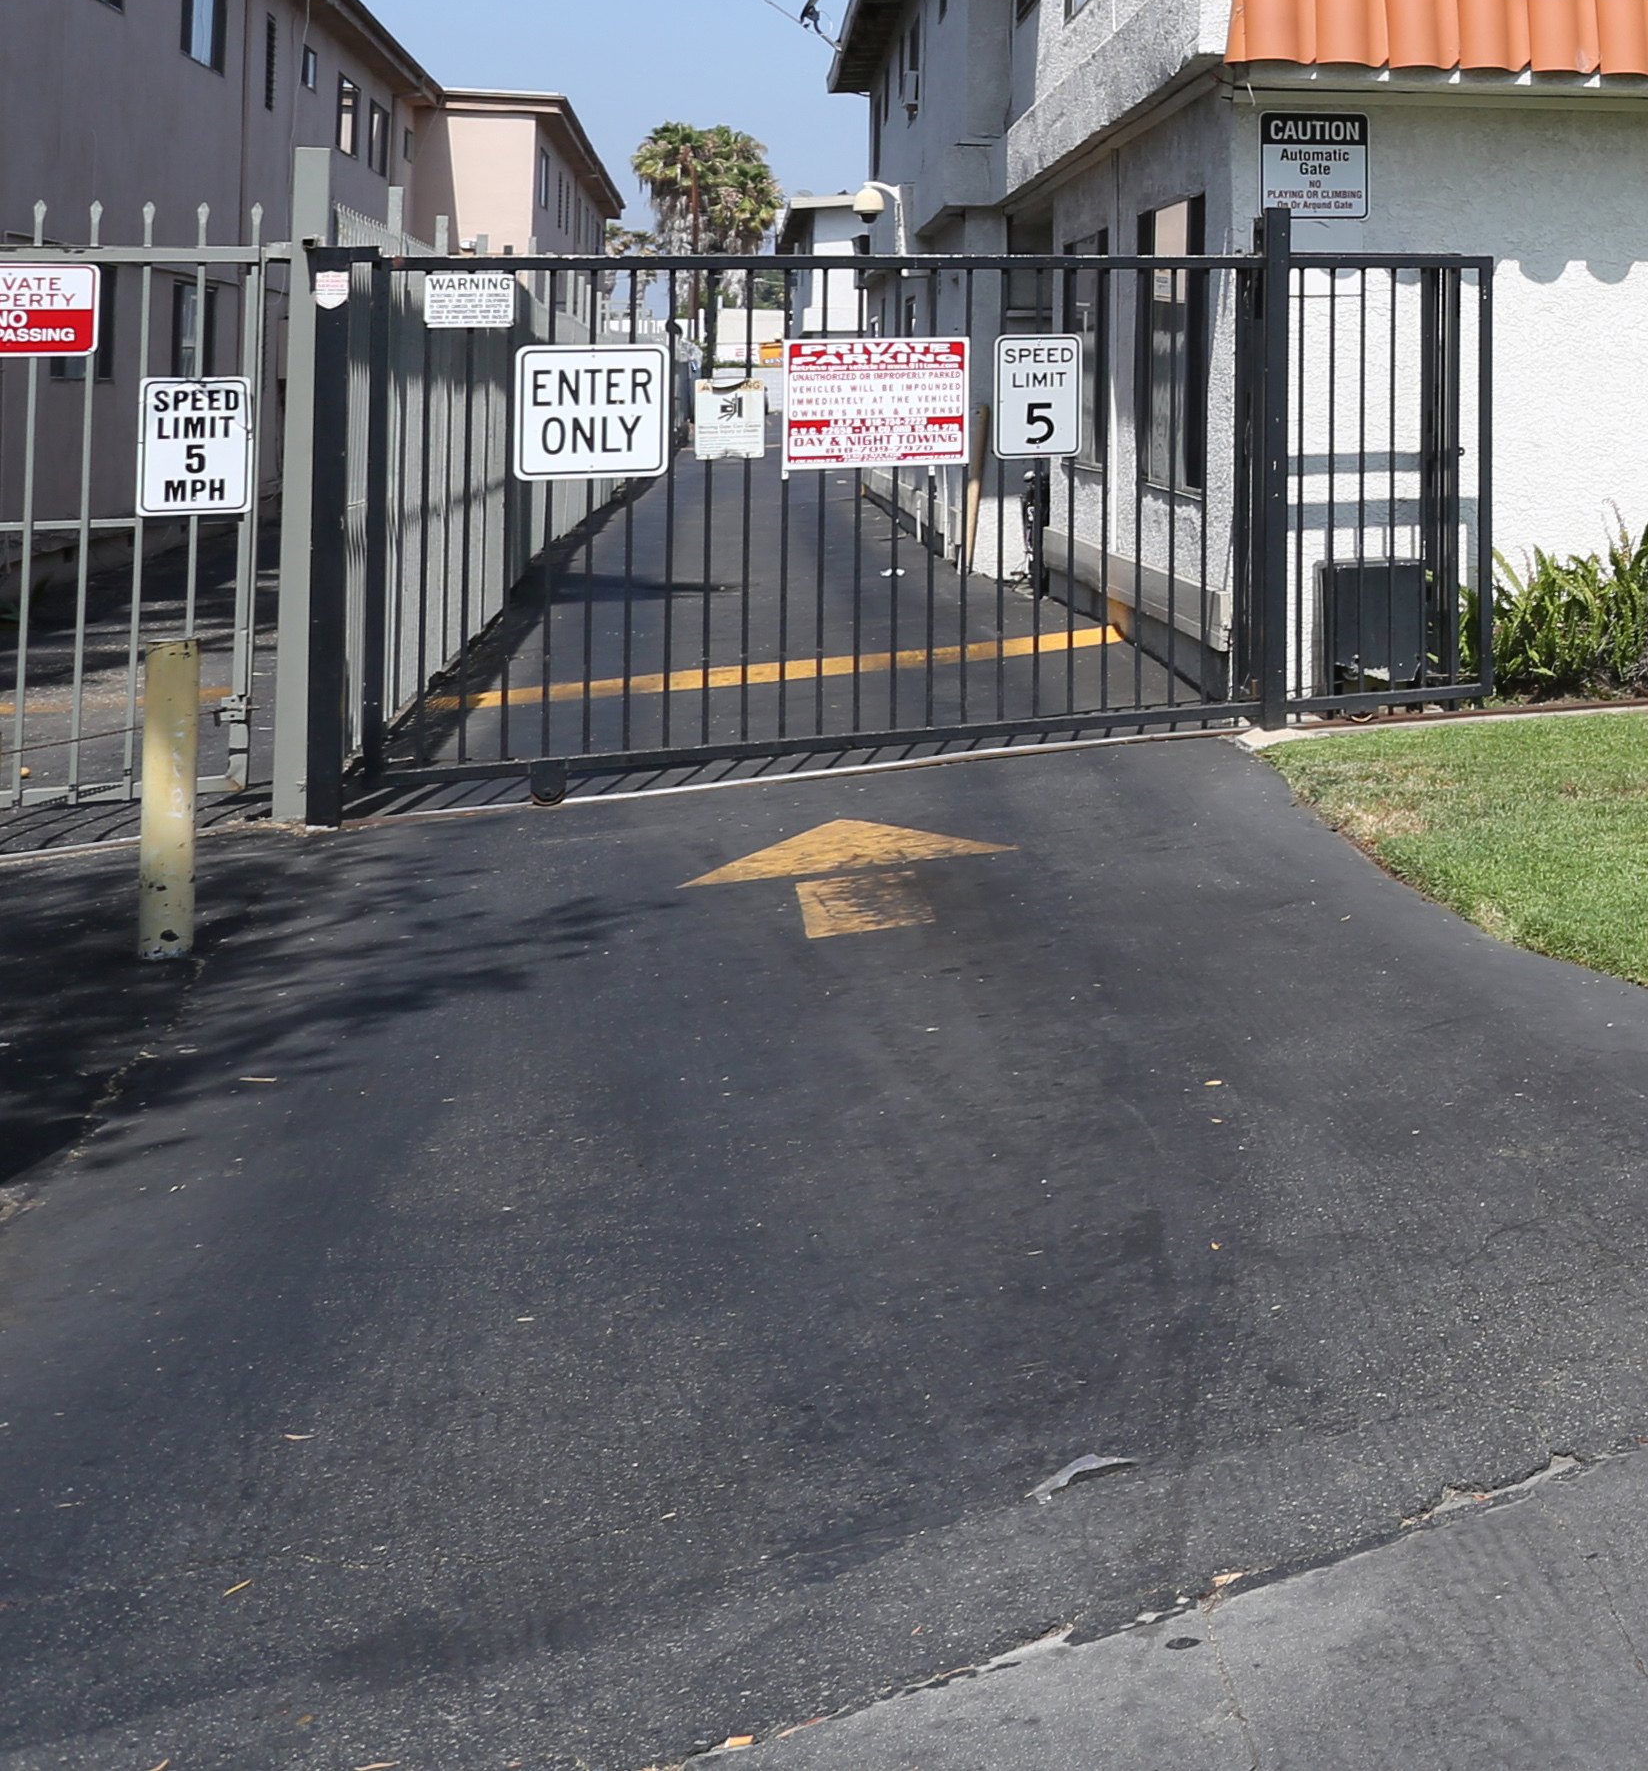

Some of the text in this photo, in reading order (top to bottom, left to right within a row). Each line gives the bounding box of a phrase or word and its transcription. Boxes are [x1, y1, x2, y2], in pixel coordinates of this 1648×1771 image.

[1270, 120, 1360, 141] CAUTION
[1280, 148, 1350, 162] Automatic
[1299, 162, 1331, 176] Gate
[1309, 180, 1322, 189] NO
[1267, 190, 1363, 199] PLAYING OR CLIMBING
[1291, 201, 1301, 209] Or
[1303, 201, 1332, 209] Around
[1334, 201, 1353, 209] Gate
[2, 277, 62, 291] VATE
[428, 277, 511, 291] WARNING
[0, 327, 76, 342] ASSING
[801, 343, 950, 354] PRIVATE
[1004, 347, 1074, 364] SPEED
[791, 353, 962, 365] PARKING
[792, 371, 961, 382] UNAUTHORIZED OR IMPROPERLY PARKED
[1012, 372, 1067, 388] LIMIT
[532, 367, 653, 407] ENTER
[792, 382, 961, 394] VEHICLES WILL BE IMPOUNDED
[153, 389, 240, 412] SPEED
[792, 394, 961, 406] IMMEDIATELY AT THE VEHICLE
[792, 406, 961, 418] OWNER'S RISK & EXPENSE
[157, 416, 235, 439] LIMIT
[1025, 402, 1055, 445] 5
[541, 415, 643, 456] ONLY
[794, 432, 958, 447] DAY & NIGHT TOWING
[185, 444, 206, 474] 5
[164, 479, 225, 502] MPH
